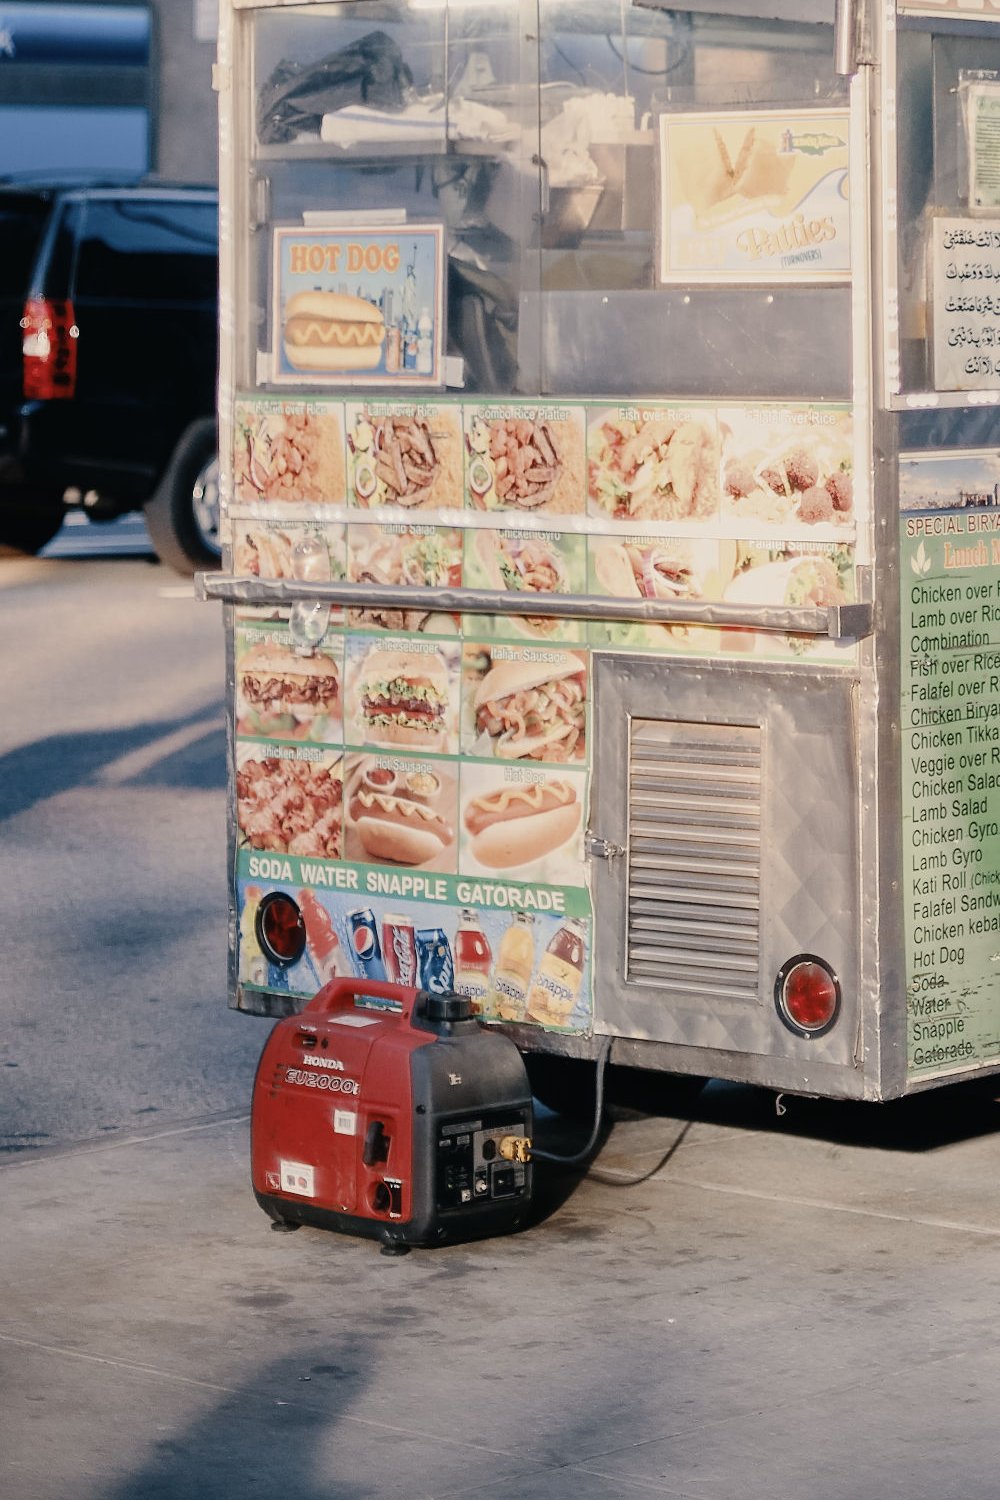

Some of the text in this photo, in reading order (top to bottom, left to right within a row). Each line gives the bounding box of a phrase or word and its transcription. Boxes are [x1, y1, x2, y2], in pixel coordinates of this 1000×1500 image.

[736, 215, 836, 260] Patties
[289, 243, 401, 274] HOT DOG
[368, 405, 394, 417] Lamb
[417, 406, 438, 418] Rice
[477, 408, 510, 419] Combo
[512, 408, 535, 420] Rice
[619, 409, 691, 421] Fish over Rice
[811, 411, 835, 424] Rice
[406, 524, 436, 536] Salad
[906, 516, 964, 537] SPECIAL
[788, 539, 839, 553] Sandwich
[943, 542, 989, 569] Lunch
[911, 585, 962, 605] Chicken
[966, 582, 993, 599] over
[911, 610, 946, 629] Lamb
[950, 609, 977, 625] over
[911, 631, 990, 653] Combination
[490, 646, 567, 665] Italian Sausage
[911, 653, 1000, 678] Fish over Rice
[911, 680, 954, 702] Falafel
[958, 679, 985, 696] over
[911, 706, 962, 727] Chicken
[911, 729, 962, 751] Chicken
[375, 755, 433, 775] Hot Sausage
[911, 756, 956, 777] Veggie
[959, 752, 988, 769] over
[504, 767, 547, 787] Hot Dog
[912, 778, 963, 800] Chicken
[912, 798, 988, 823] Lamb Salad
[912, 820, 999, 848] Chicken Gyro
[912, 848, 983, 872] Lamb Gyro
[249, 856, 566, 912] SODA WATER SNAPPLE GATORADE
[912, 876, 938, 896] Kati
[942, 871, 967, 890] Roll
[913, 899, 957, 921] Falafel
[913, 922, 965, 945] Chicken
[913, 946, 965, 969] Hot Dog
[456, 982, 487, 1000] Snapple
[495, 978, 526, 1001] Snapple
[537, 972, 574, 1000] Snapple
[913, 971, 945, 994] Soda
[912, 996, 949, 1018] Water
[913, 1018, 965, 1042] Snapple
[303, 1054, 344, 1070] HONDA
[913, 1040, 974, 1066] Gatorade
[285, 1068, 360, 1095] EU2000i
